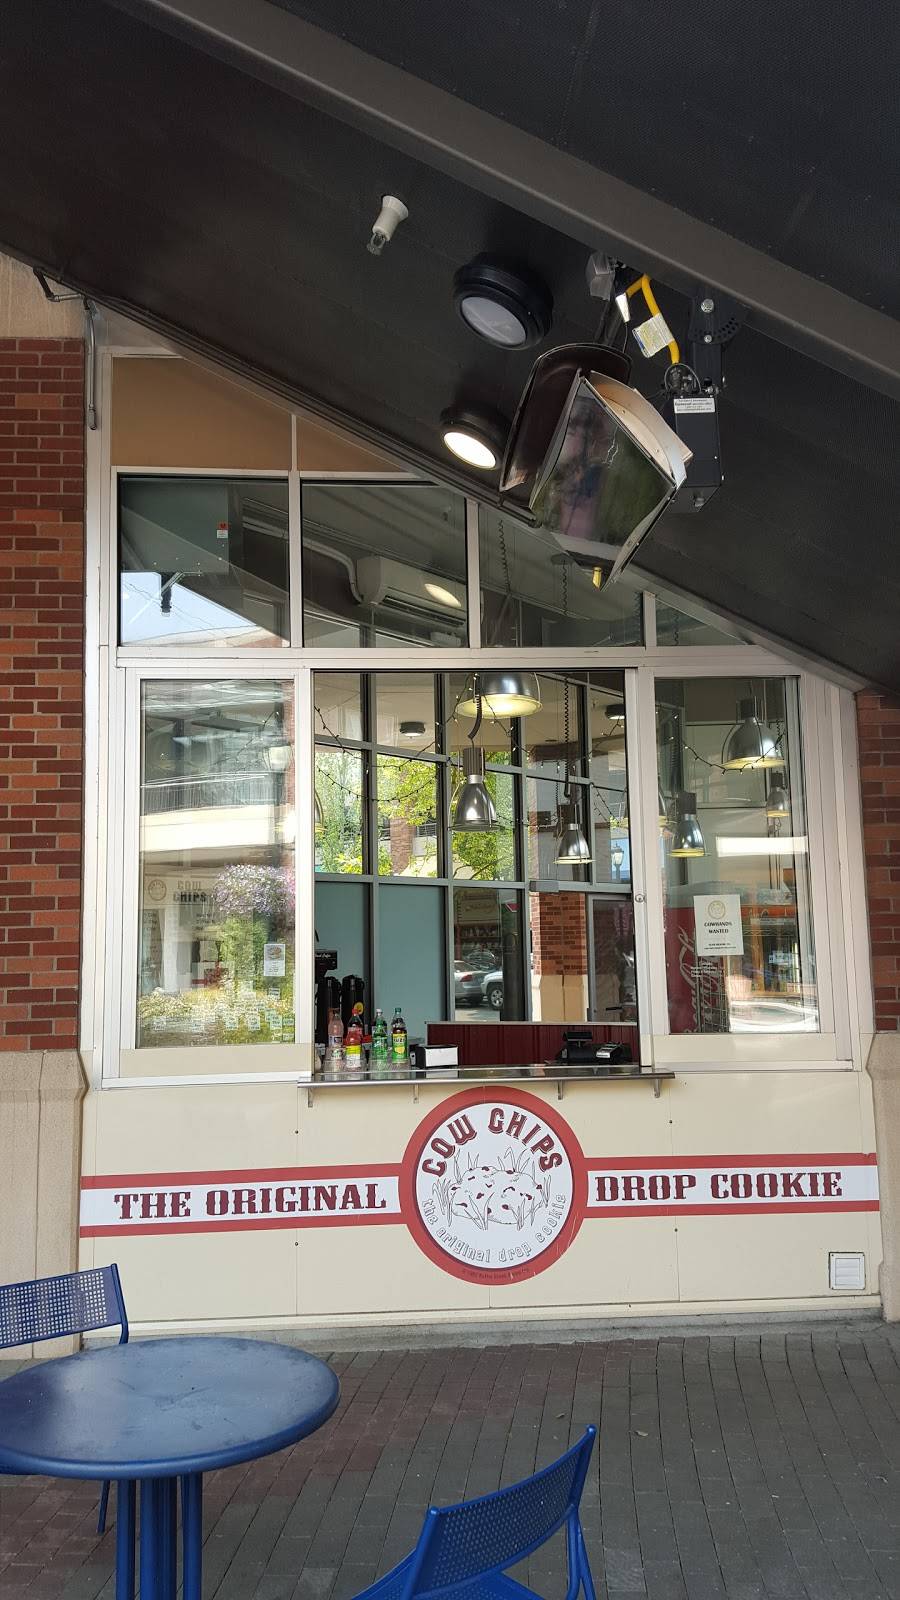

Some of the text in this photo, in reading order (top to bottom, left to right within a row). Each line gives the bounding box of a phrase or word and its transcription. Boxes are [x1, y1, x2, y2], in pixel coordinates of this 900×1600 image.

[421, 1107, 564, 1178] COW CHIPS
[114, 1183, 387, 1220] THE ORIGINAL
[594, 1171, 843, 1202] DROP COOKIE
[422, 1194, 567, 1263] the original drop cookie
